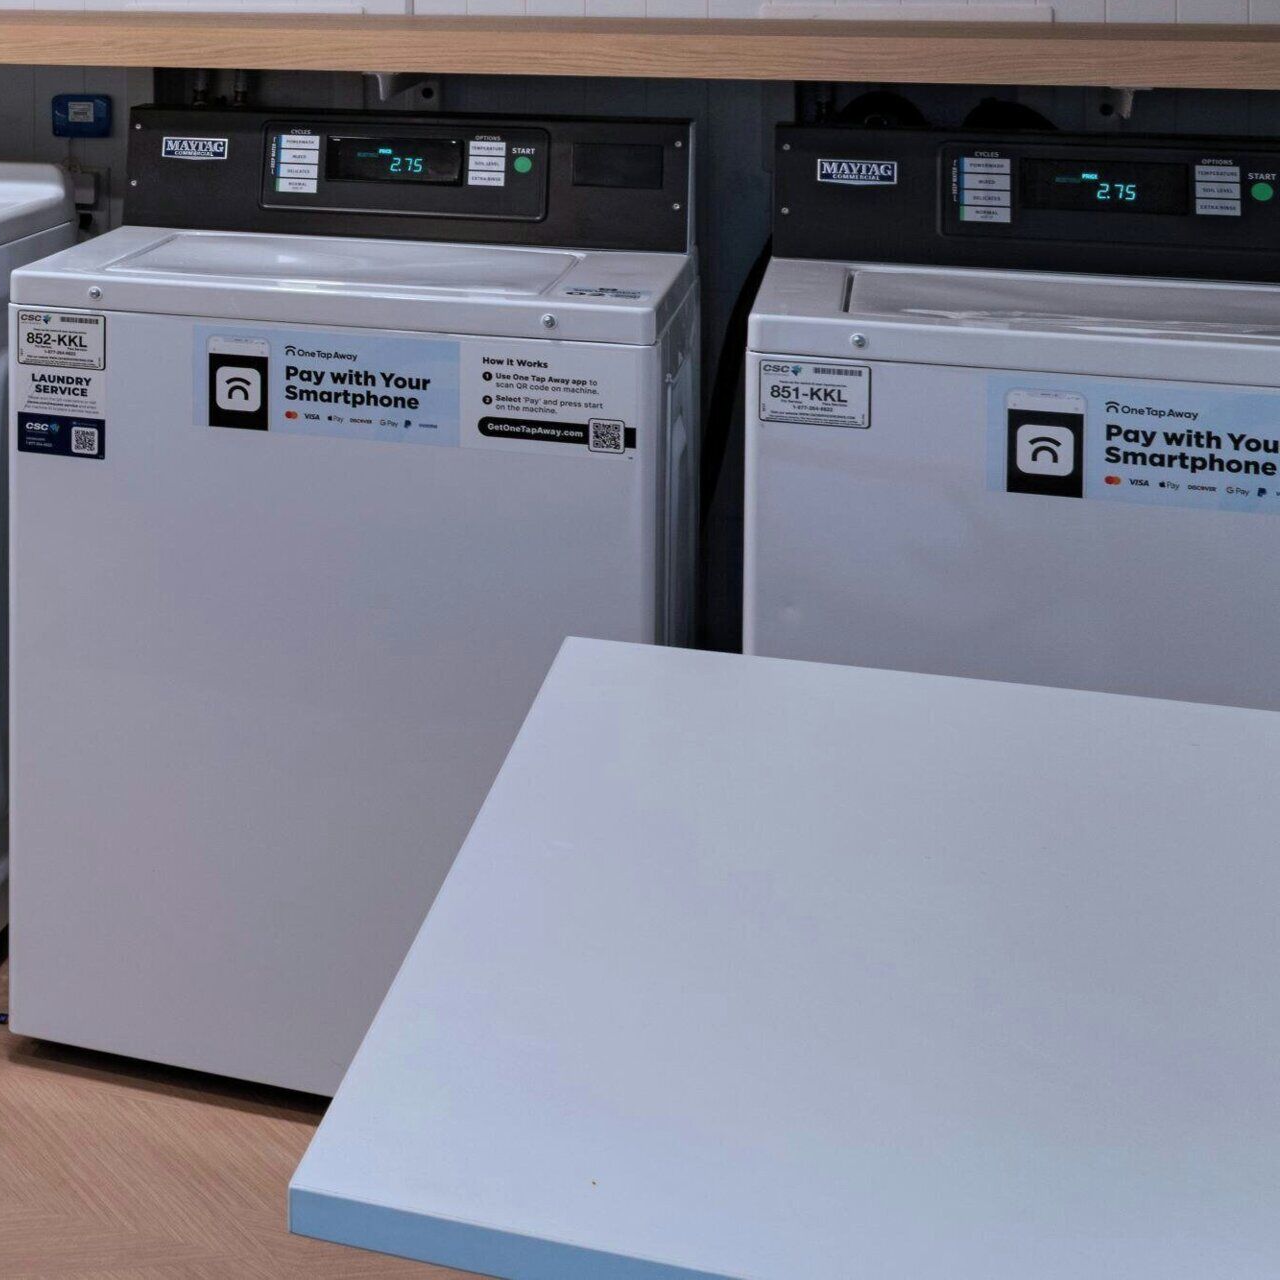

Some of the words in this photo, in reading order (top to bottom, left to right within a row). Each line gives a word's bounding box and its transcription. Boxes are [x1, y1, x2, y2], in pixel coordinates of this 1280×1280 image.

[166, 140, 224, 153] MAYTAG
[512, 147, 535, 155] START
[390, 157, 423, 173] 2.75
[822, 161, 893, 176] MAYTAG
[832, 173, 880, 181] COMMERCIAL
[1247, 172, 1277, 180] START
[1096, 183, 1137, 200] 2.75
[21, 314, 42, 322] CSC
[26, 332, 88, 348] 852-KKL
[297, 349, 316, 358] One
[482, 357, 503, 365] How
[507, 358, 514, 366] it
[516, 359, 548, 369] Works
[763, 364, 790, 373] CSC
[31, 373, 92, 386] LAUNDRY
[285, 365, 325, 386] Pay
[330, 369, 376, 387] with
[380, 371, 431, 390] Your
[531, 375, 545, 383] Tap
[548, 377, 570, 385] Away
[572, 379, 587, 387] app
[35, 384, 88, 397] SERVICE
[516, 382, 528, 390] QR
[529, 384, 549, 392] code
[563, 387, 599, 395] machine.
[770, 384, 848, 403] 851-KKL
[285, 385, 419, 409] Smartphone
[495, 395, 521, 403] Select
[584, 401, 603, 409] start
[522, 406, 558, 414] machine.
[1121, 405, 1145, 415] One
[1167, 408, 1199, 421] Away
[25, 422, 49, 431] CSC
[333, 415, 344, 424] Pay
[387, 420, 399, 428] Pay
[487, 423, 584, 438] GetOneTapAway.com
[1105, 424, 1157, 447] Pay
[1163, 429, 1222, 450] with
[1227, 432, 1279, 454] You
[1105, 446, 1277, 476] Smartphone
[1129, 478, 1150, 487] VISA
[1166, 481, 1180, 490] Pay
[1187, 484, 1217, 492] DISCOVER
[1235, 487, 1249, 497] Pay
